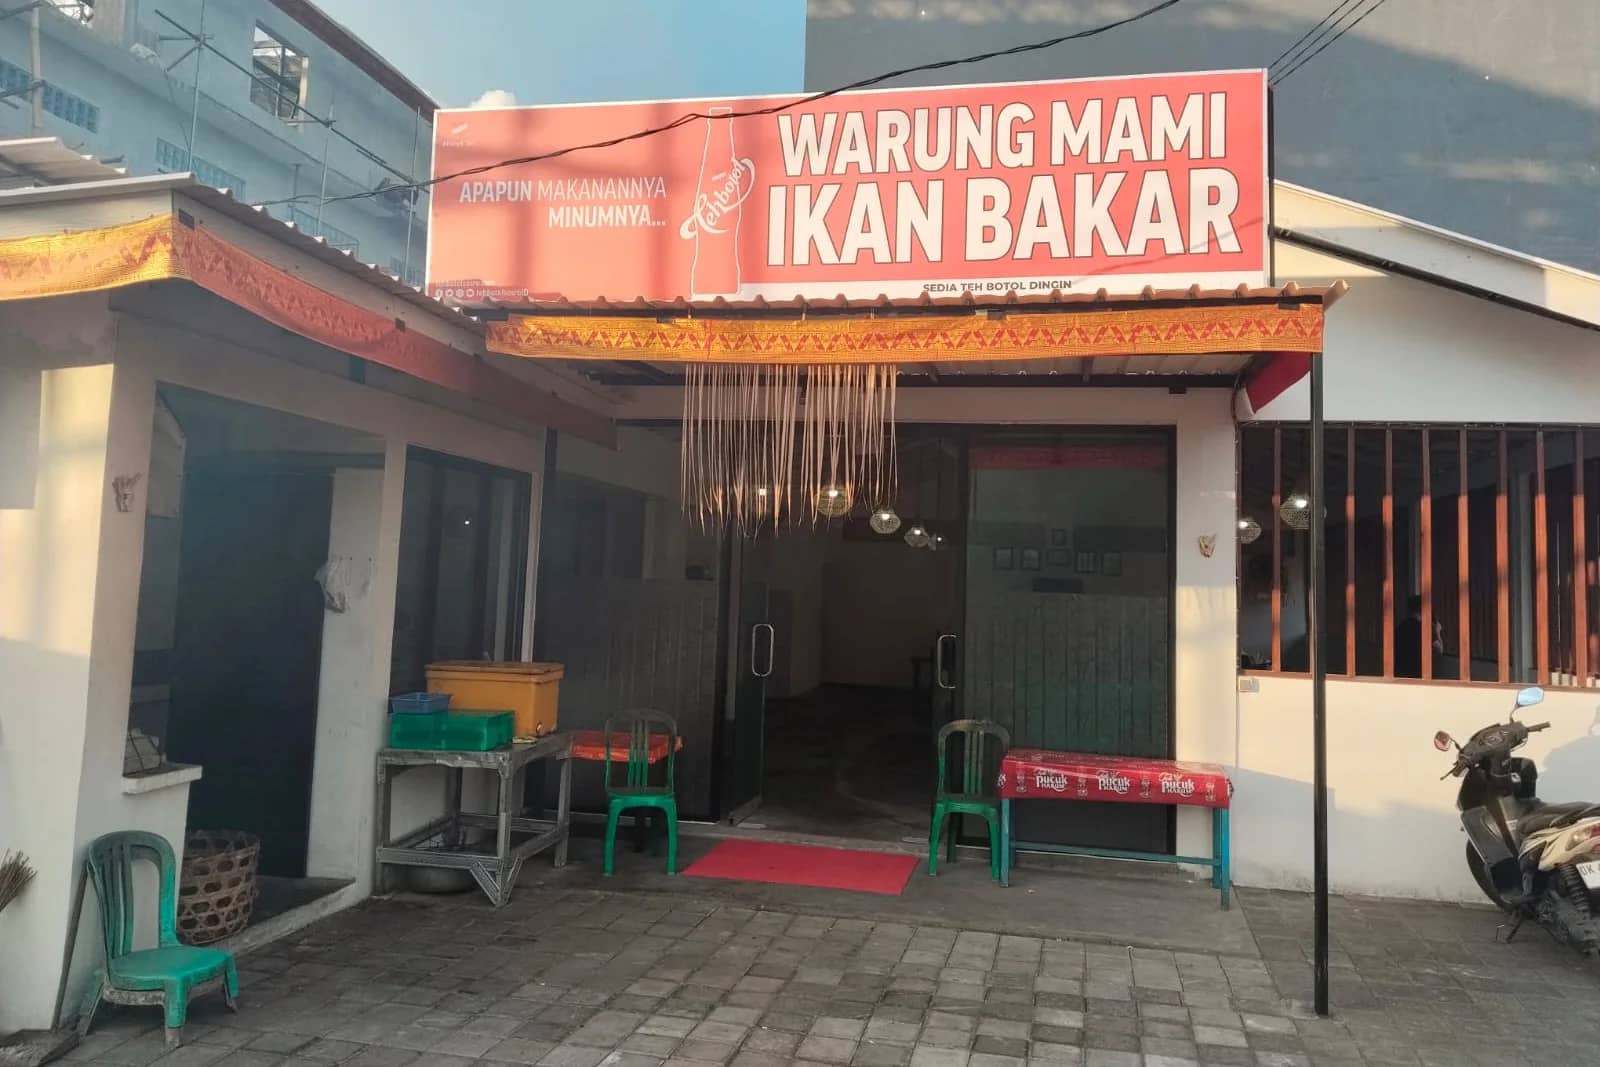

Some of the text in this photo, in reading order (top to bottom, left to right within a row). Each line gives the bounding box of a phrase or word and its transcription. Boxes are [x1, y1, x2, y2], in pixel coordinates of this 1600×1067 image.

[777, 91, 1227, 177] WARUNG MAMI
[459, 176, 667, 203] APAPUN MAKANANNYA
[548, 204, 667, 228] MINUMNYA...
[767, 167, 1242, 266] IKAN BAKAR
[923, 280, 1072, 292] SEDIA TEH BOTOL DINGIN
